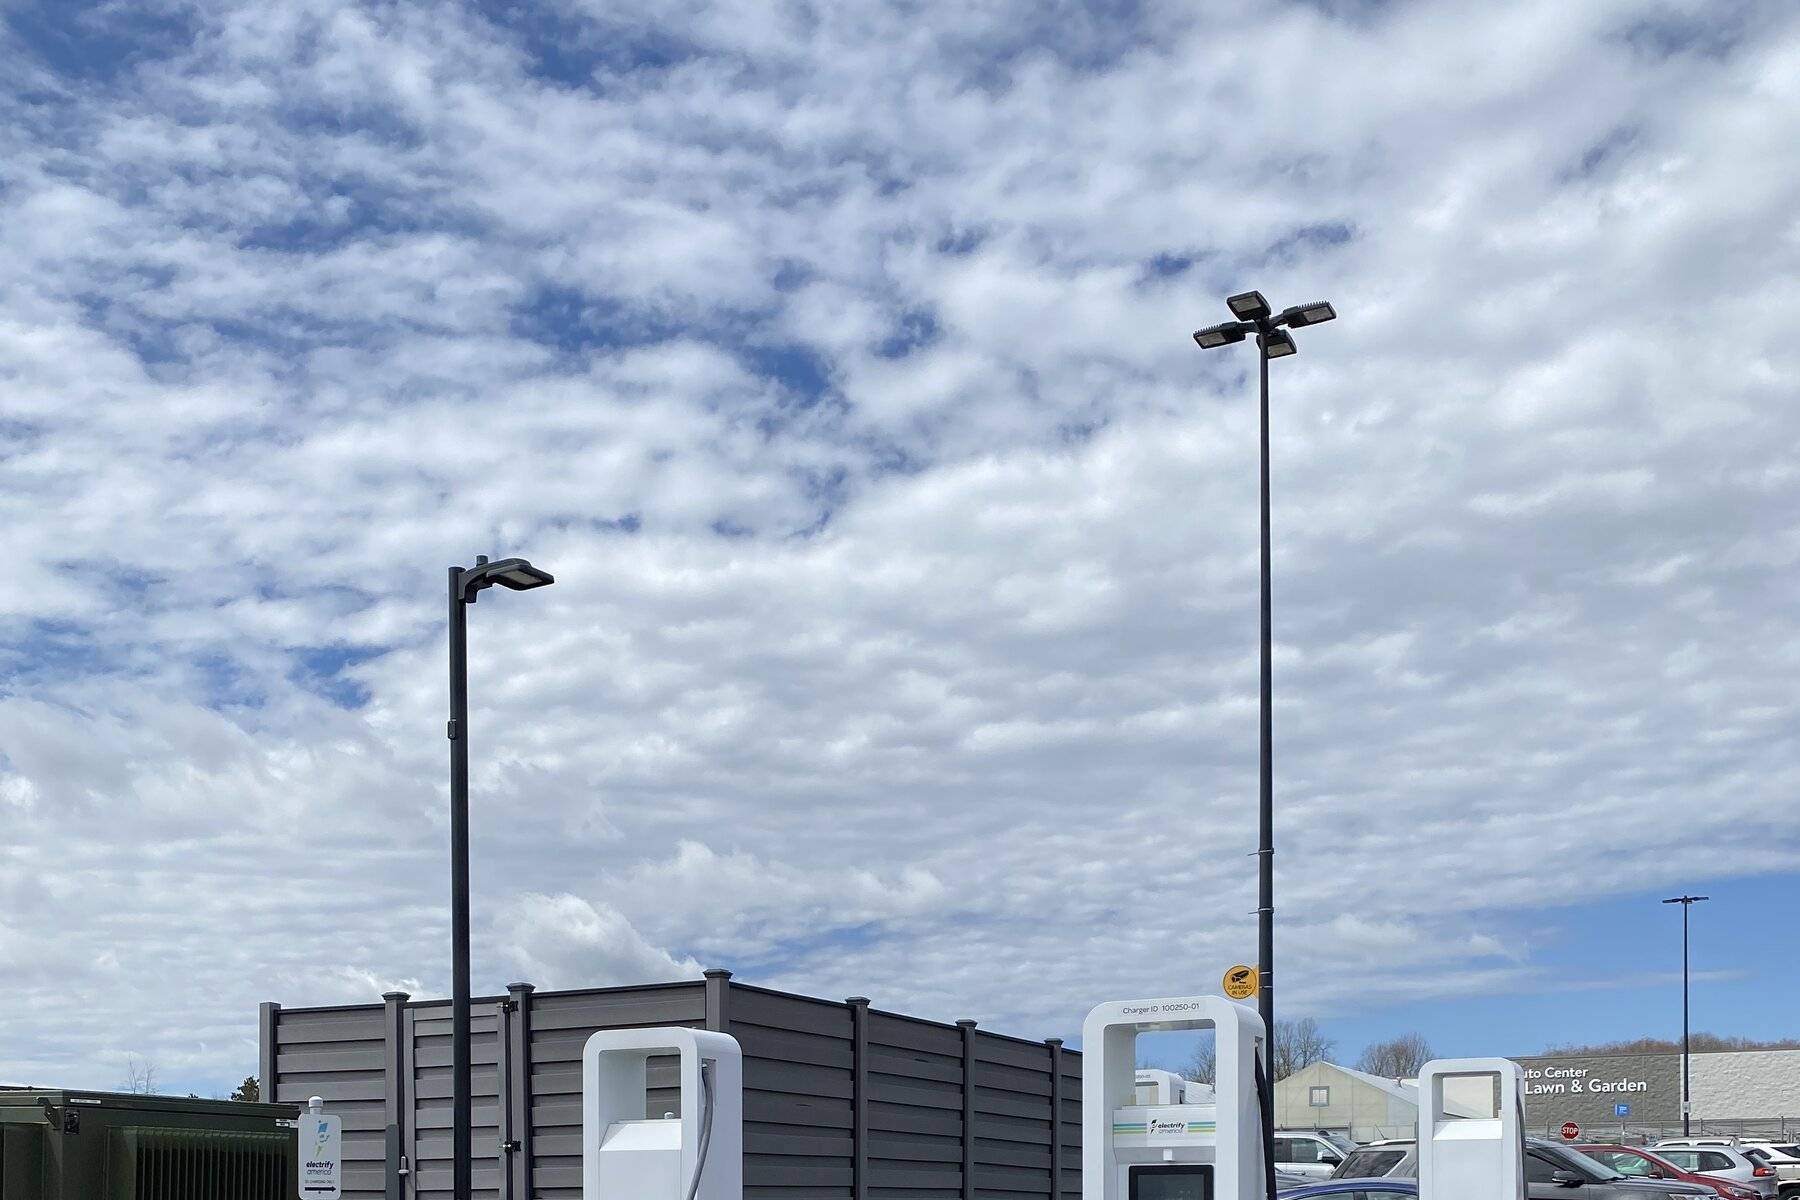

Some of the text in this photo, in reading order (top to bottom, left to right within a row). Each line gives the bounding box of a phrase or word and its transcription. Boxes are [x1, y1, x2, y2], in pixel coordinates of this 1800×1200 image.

[1122, 1007, 1149, 1015] Charger
[1524, 1066, 1588, 1078] uto Center
[1525, 1078, 1647, 1095] Lawn & Garden
[1157, 1122, 1185, 1130] electrify
[1562, 1127, 1578, 1135] STOP
[306, 1161, 334, 1169] electrify
